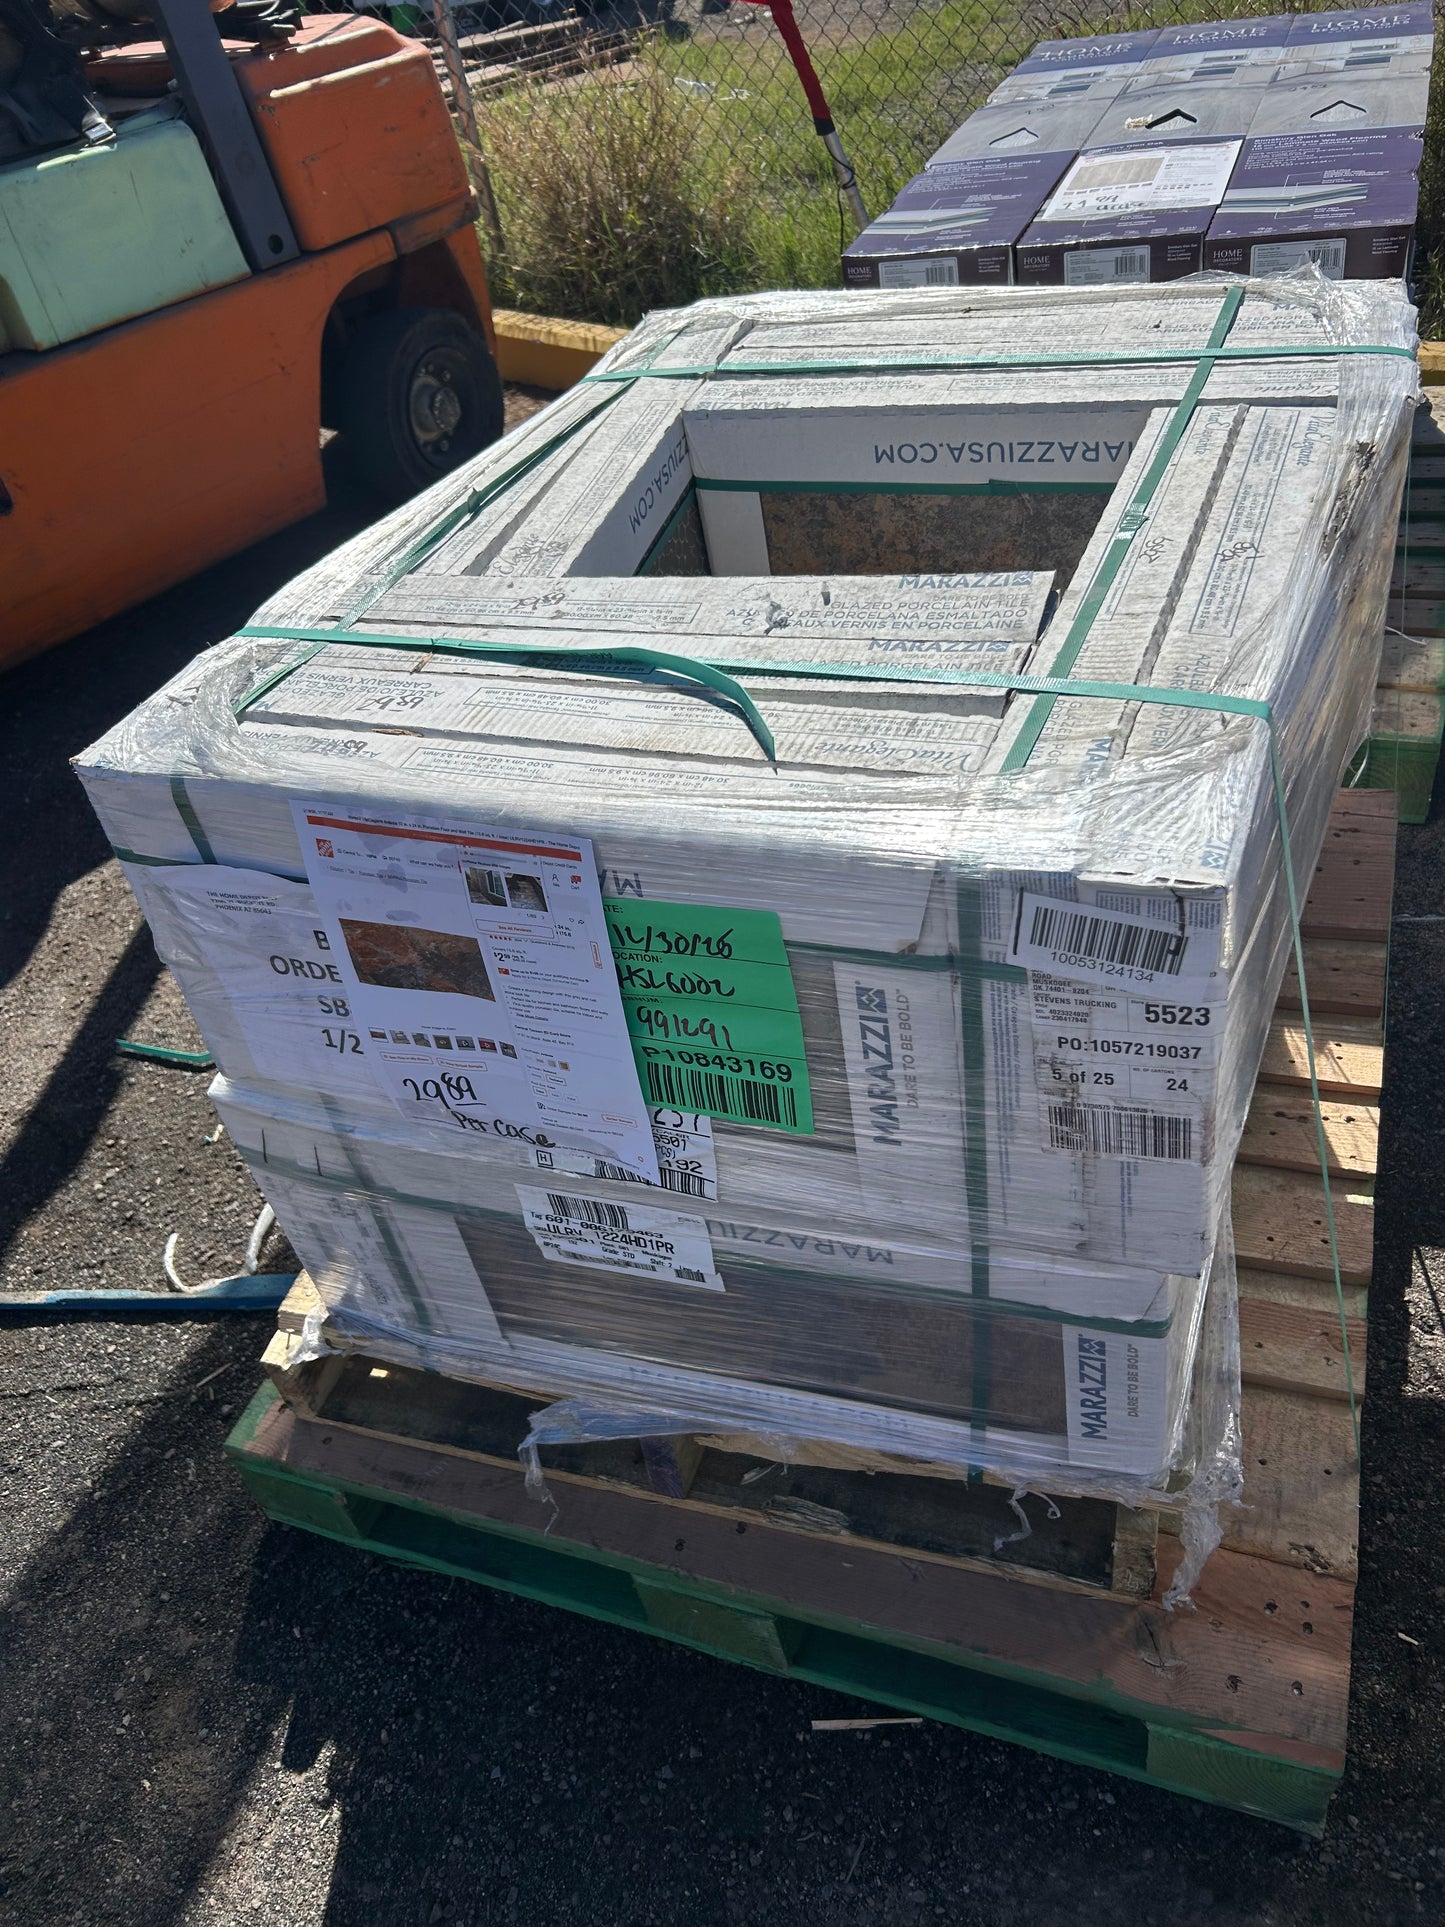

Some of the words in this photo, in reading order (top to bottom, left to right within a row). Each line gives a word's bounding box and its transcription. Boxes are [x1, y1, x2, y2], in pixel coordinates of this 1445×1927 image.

[1312, 14, 1411, 31] HOME
[1175, 26, 1268, 41] HOME
[1023, 256, 1051, 265] HOME
[1213, 248, 1243, 258] HOME
[847, 266, 872, 275] HOME
[898, 572, 1011, 589] MARAZZI
[830, 600, 894, 611] GLAZED
[897, 600, 992, 610] PORCELAIN
[994, 597, 1030, 608] TILE
[799, 609, 819, 619] DE
[822, 608, 921, 619] PORCELANA
[924, 607, 1029, 619] ESMALTADO
[829, 619, 888, 630] VERNIS
[892, 619, 917, 630] EN
[919, 618, 1024, 630] PORCELAINE
[867, 640, 985, 652] MARAZZI
[358, 677, 433, 690] CARREAUX
[380, 686, 446, 698] AZULEJO
[1050, 951, 1154, 983] 10053124134
[1032, 978, 1072, 987] MUSKOGEE
[1033, 995, 1071, 1005] STEVENS
[1073, 999, 1117, 1009] TRUCKING
[1144, 1003, 1211, 1027] 5523
[321, 1028, 365, 1055] 1/2
[900, 1034, 914, 1052] BE
[1057, 1036, 1202, 1060] PO:1057219037
[640, 1045, 793, 1083] P10843169
[901, 1054, 917, 1072] TO
[859, 1014, 903, 1147] MARAZZI
[1052, 1068, 1063, 1081] 5
[1069, 1071, 1086, 1084] of
[1093, 1072, 1115, 1086] 25
[904, 1074, 919, 1109] DARE
[1166, 1078, 1189, 1092] 24
[663, 1159, 704, 1175] 192
[547, 1223, 583, 1237] ULRV
[595, 1231, 676, 1255] 1224HD1PR
[622, 1250, 635, 1259] STD
[1127, 1370, 1139, 1382] BE
[1128, 1383, 1139, 1396] TO
[1078, 1355, 1107, 1440] MARAZZI
[1127, 1396, 1139, 1418] DARE
